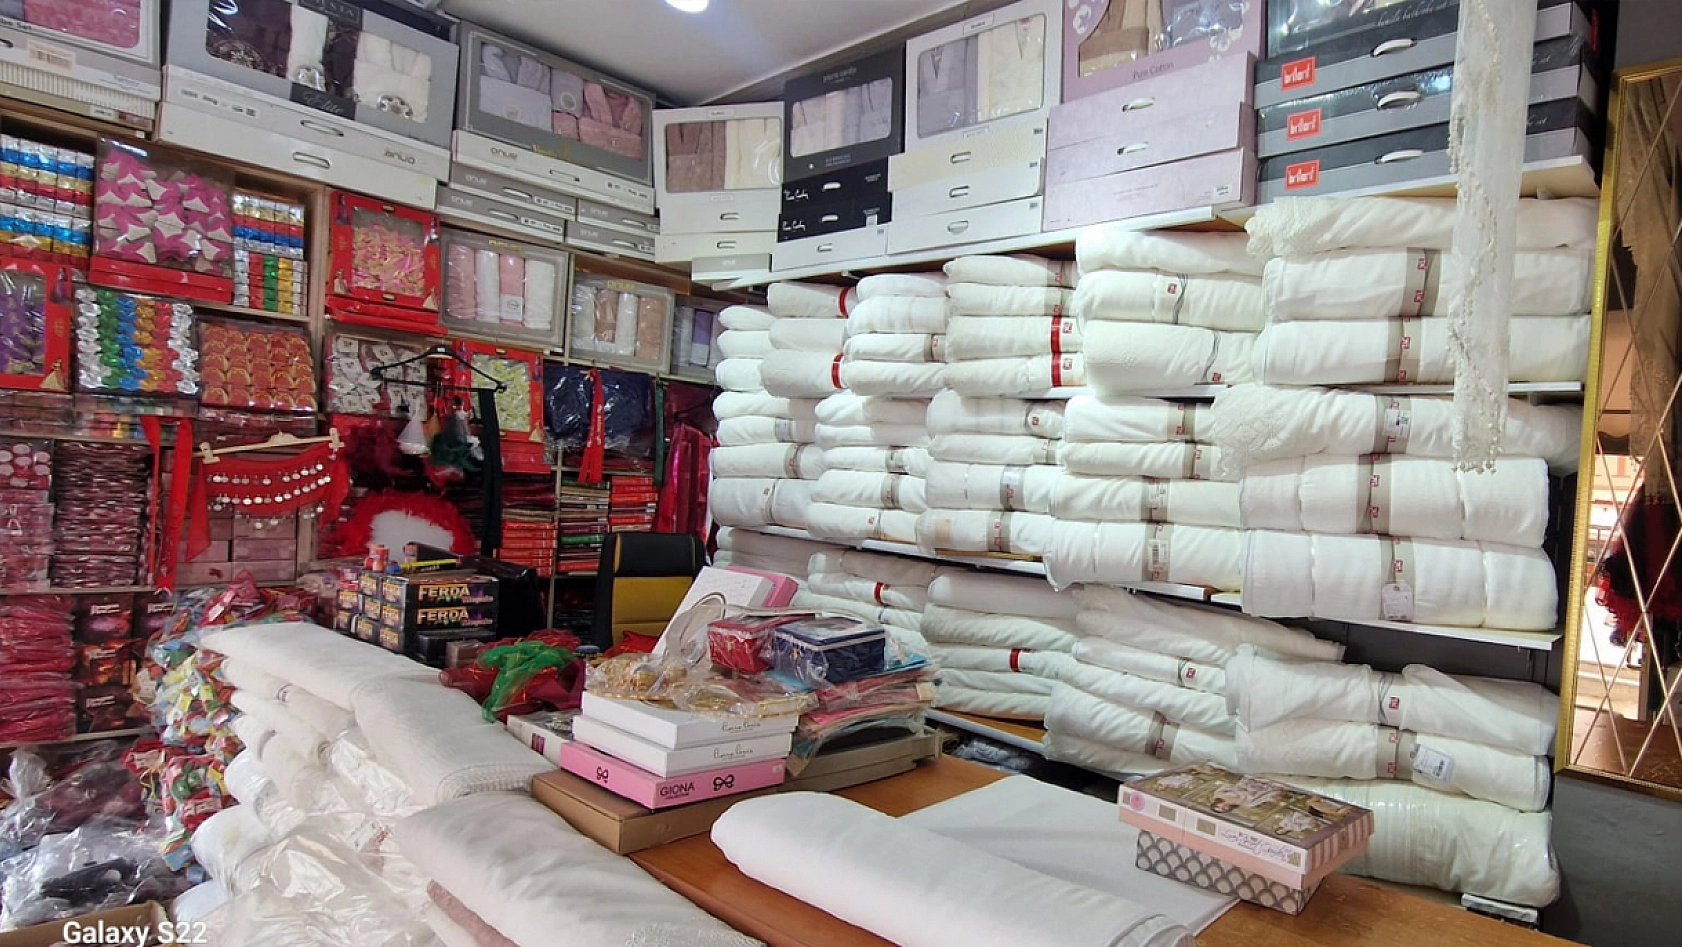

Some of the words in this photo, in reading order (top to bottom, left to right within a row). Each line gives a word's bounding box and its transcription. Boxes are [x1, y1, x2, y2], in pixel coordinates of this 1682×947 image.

[1133, 69, 1148, 80] Pure
[1149, 62, 1175, 76] Cotton
[418, 584, 470, 600] FERDA
[416, 606, 469, 624] FERDA
[660, 782, 695, 797] GIONA
